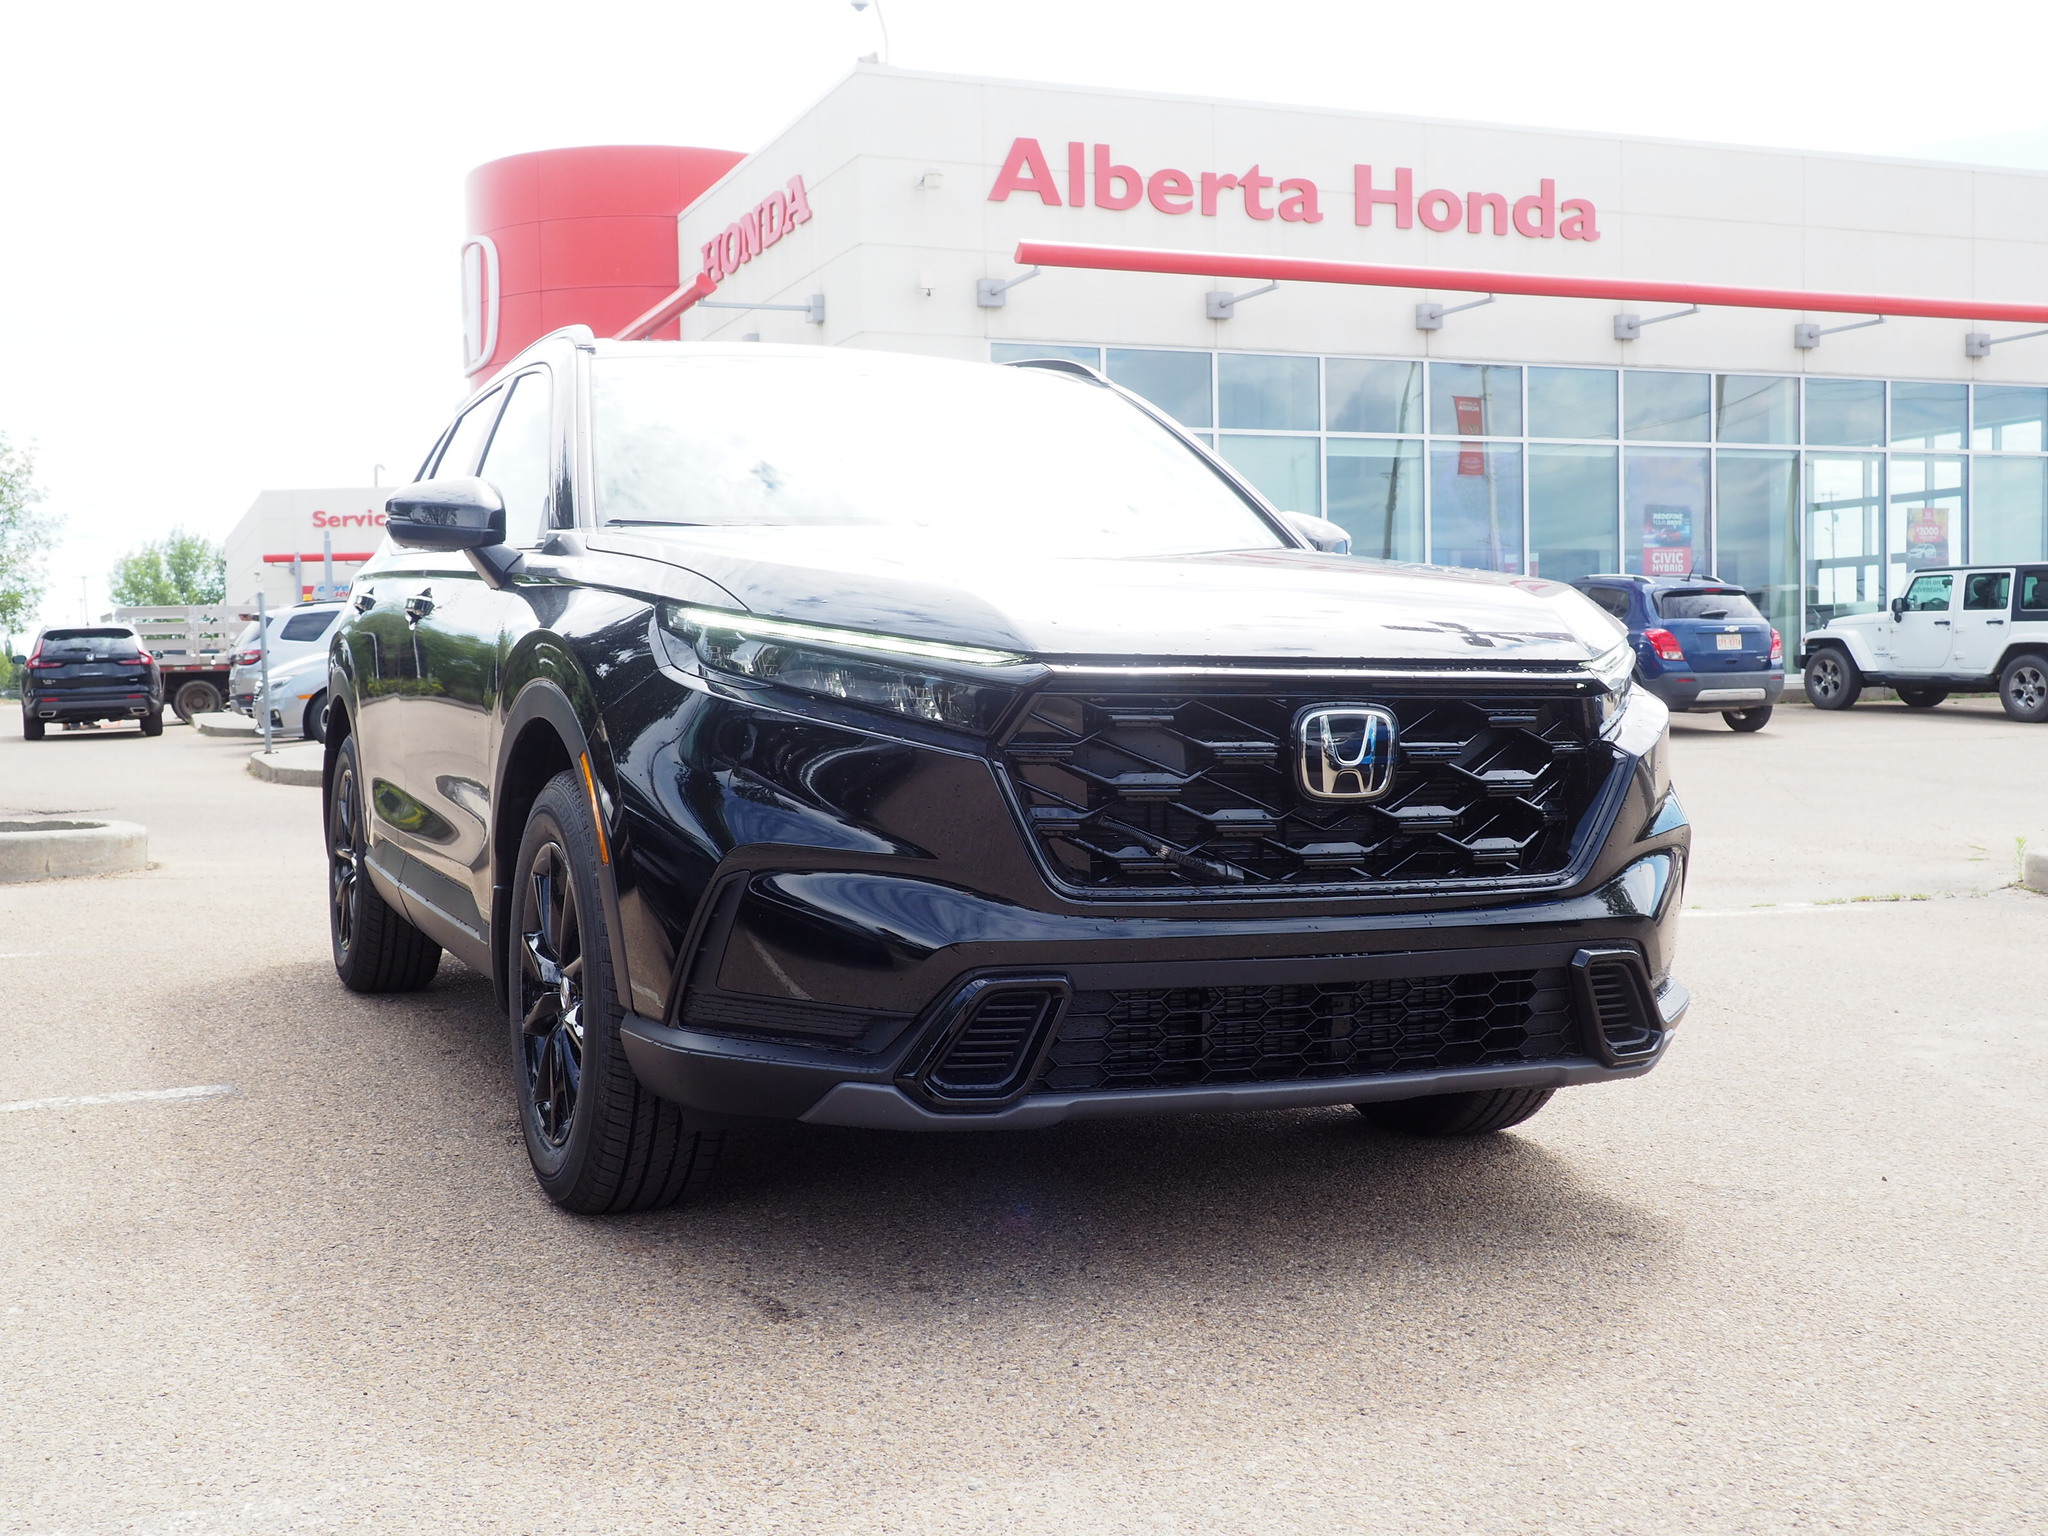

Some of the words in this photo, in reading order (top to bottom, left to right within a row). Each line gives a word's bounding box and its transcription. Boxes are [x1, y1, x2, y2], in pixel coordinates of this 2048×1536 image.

[987, 136, 1324, 224] Alberta
[1353, 163, 1601, 242] Honda
[700, 174, 813, 284] HONDA
[312, 509, 386, 529] Servic
[1652, 552, 1684, 564] CIVIC
[1652, 564, 1684, 572] HYBRID
